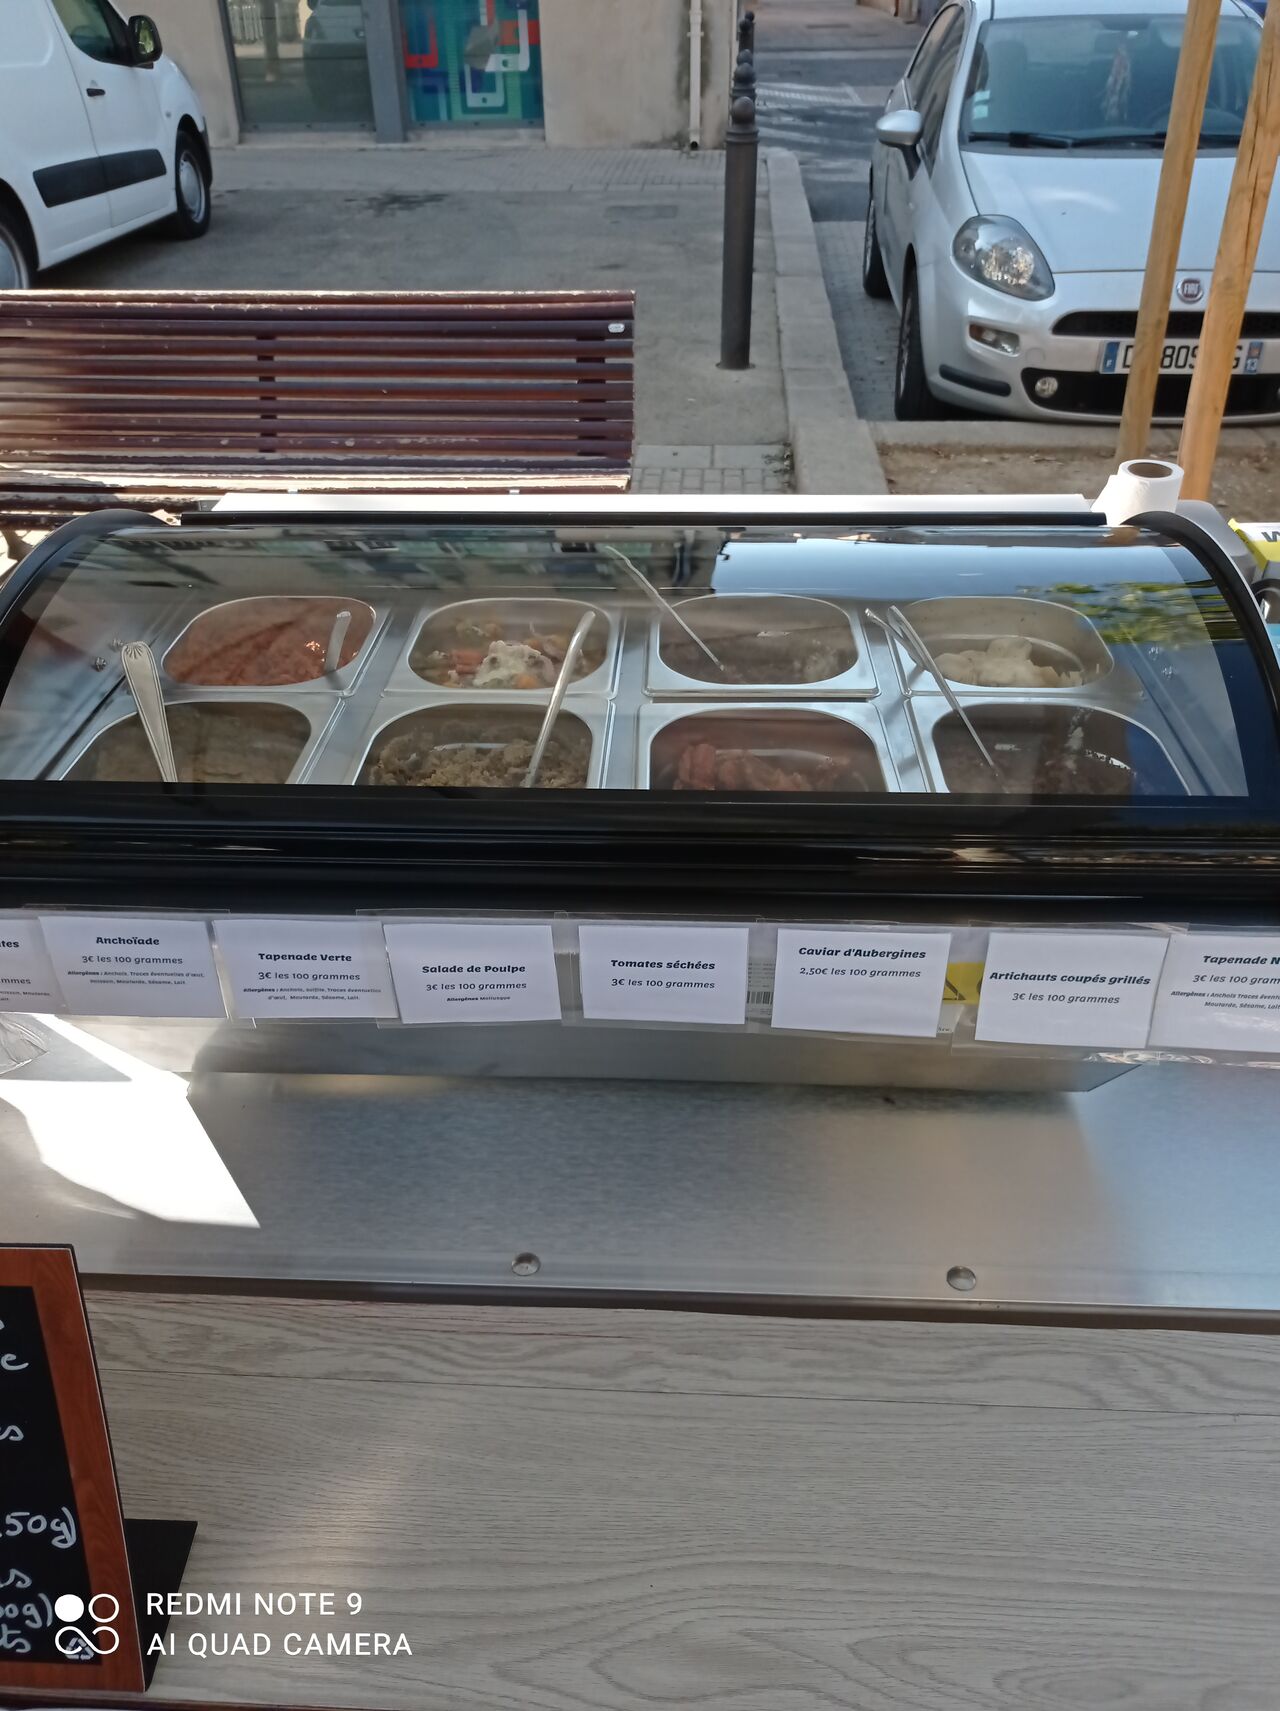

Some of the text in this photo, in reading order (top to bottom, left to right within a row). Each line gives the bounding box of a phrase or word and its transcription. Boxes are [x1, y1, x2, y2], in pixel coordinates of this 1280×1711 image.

[0, 940, 20, 948] tes
[96, 936, 160, 946] Anchoïade
[258, 953, 352, 962] Tapenade Verte
[799, 947, 926, 960] Caviar d'Aubergines
[82, 955, 183, 965] 3€ les 100 grammes
[610, 959, 716, 970] Tomates séchées
[1203, 955, 1267, 965] Tapenade
[422, 965, 526, 974] Salade de Poulpe
[799, 967, 829, 976] 2,50€
[831, 967, 846, 976] les
[869, 969, 921, 978] grammes
[258, 972, 272, 980] 3€
[275, 972, 289, 980] les
[312, 973, 360, 981] grammes
[989, 972, 1151, 985] Artichauts coupés grillés
[1193, 975, 1207, 983] 3€
[1210, 975, 1226, 983] les
[478, 982, 527, 991] grammes
[611, 978, 625, 987] 3€
[628, 979, 643, 987] les
[665, 981, 715, 989] grammes
[1012, 993, 1120, 1004] 3€ les 100 grammes
[0, 1506, 77, 1549] 50g)
